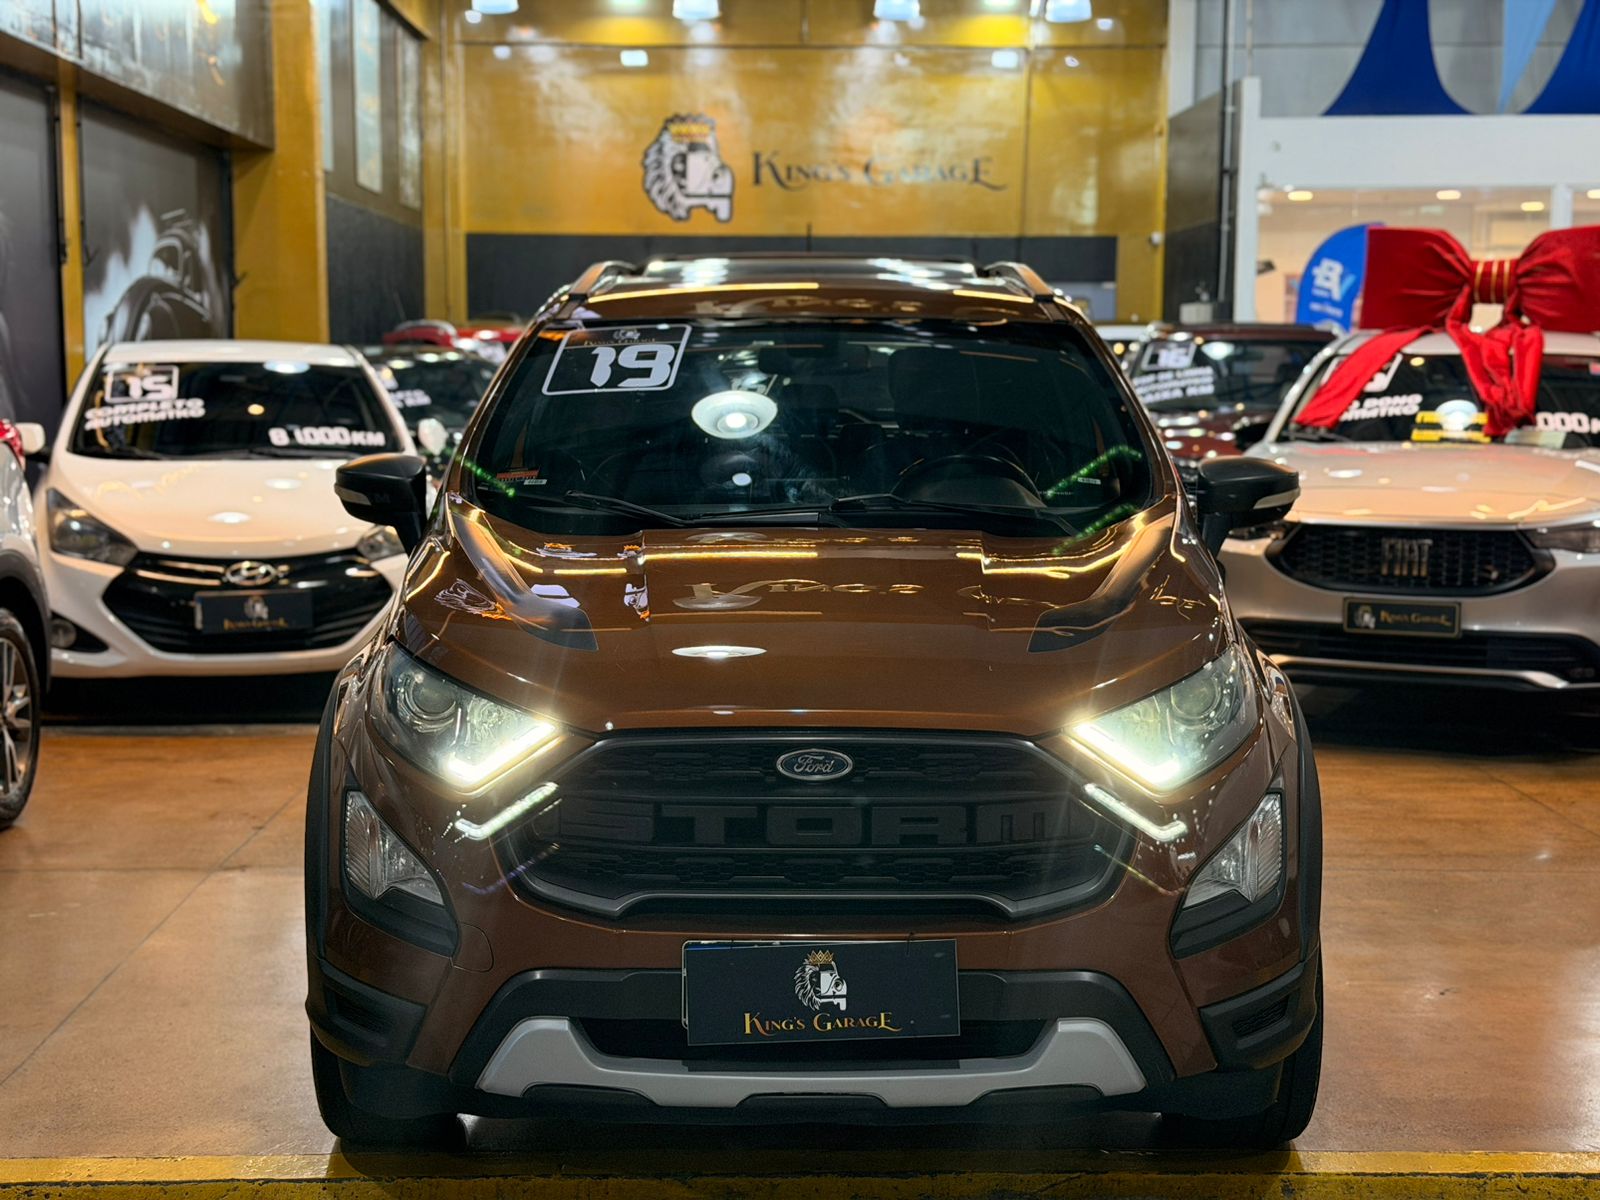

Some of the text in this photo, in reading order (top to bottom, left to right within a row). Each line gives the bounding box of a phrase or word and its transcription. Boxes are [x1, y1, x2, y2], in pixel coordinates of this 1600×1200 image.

[753, 151, 852, 192] KING'S
[590, 344, 676, 388] 19
[122, 373, 175, 401] 15
[85, 397, 205, 420] COMPLETO
[1381, 538, 1434, 577] FIAT
[793, 754, 834, 773] Ford
[561, 800, 1070, 846] STORM
[744, 1011, 903, 1037] KING'S GARAGE
